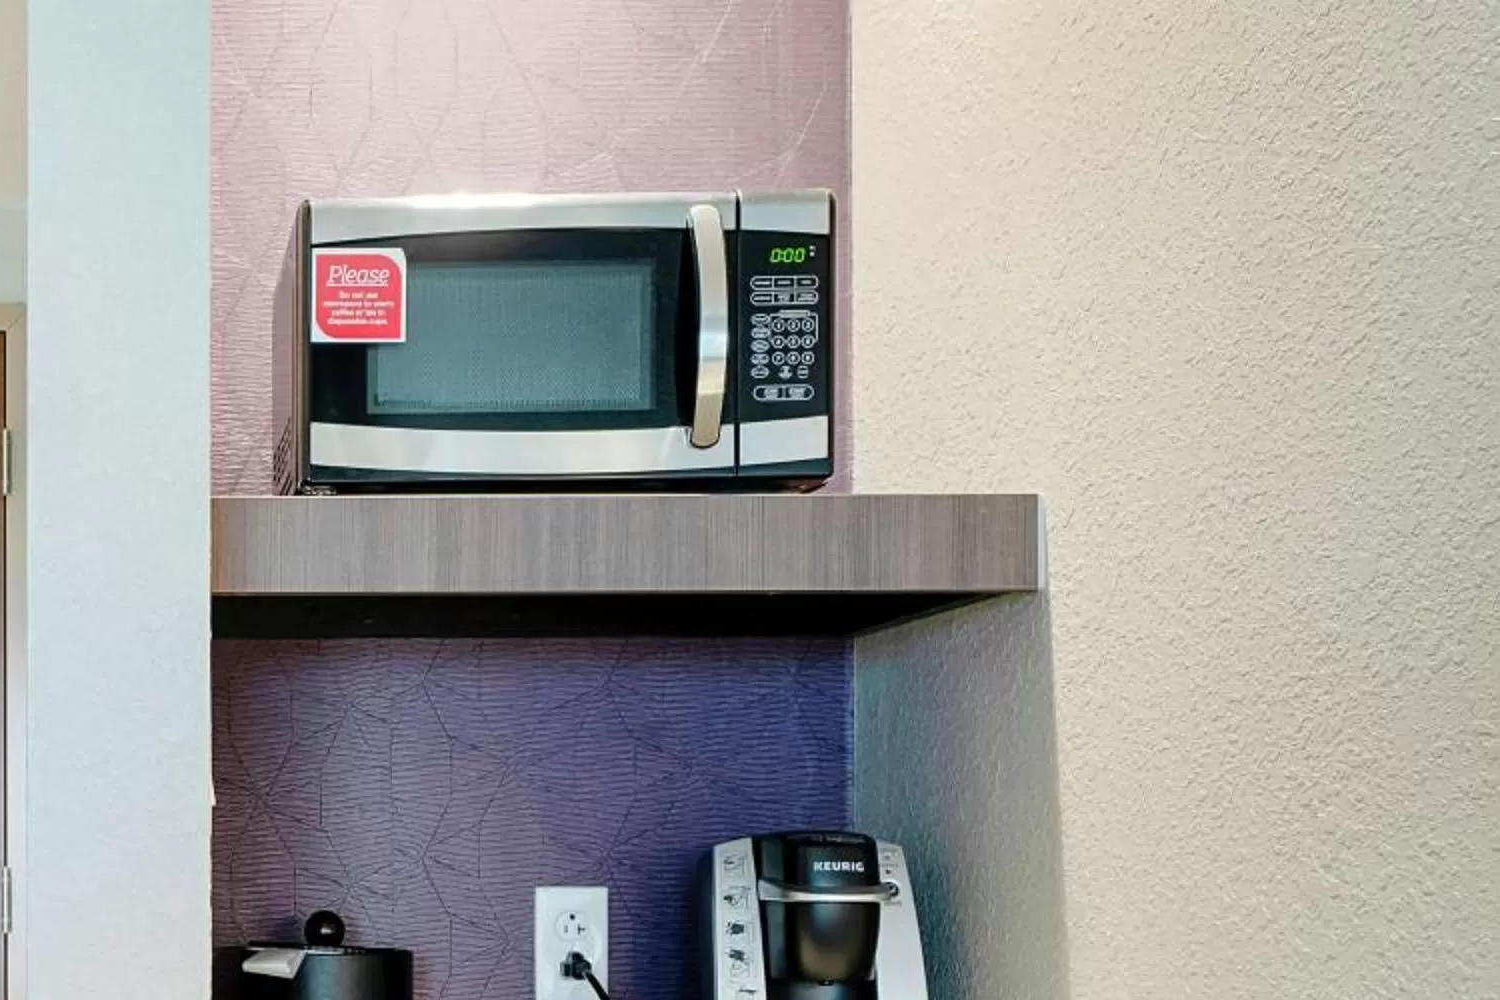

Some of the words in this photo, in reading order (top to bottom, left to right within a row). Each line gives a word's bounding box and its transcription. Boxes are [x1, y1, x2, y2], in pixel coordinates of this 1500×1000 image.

[770, 247, 805, 263] 0:00
[328, 264, 390, 285] Please
[813, 861, 865, 873] KEURIG
